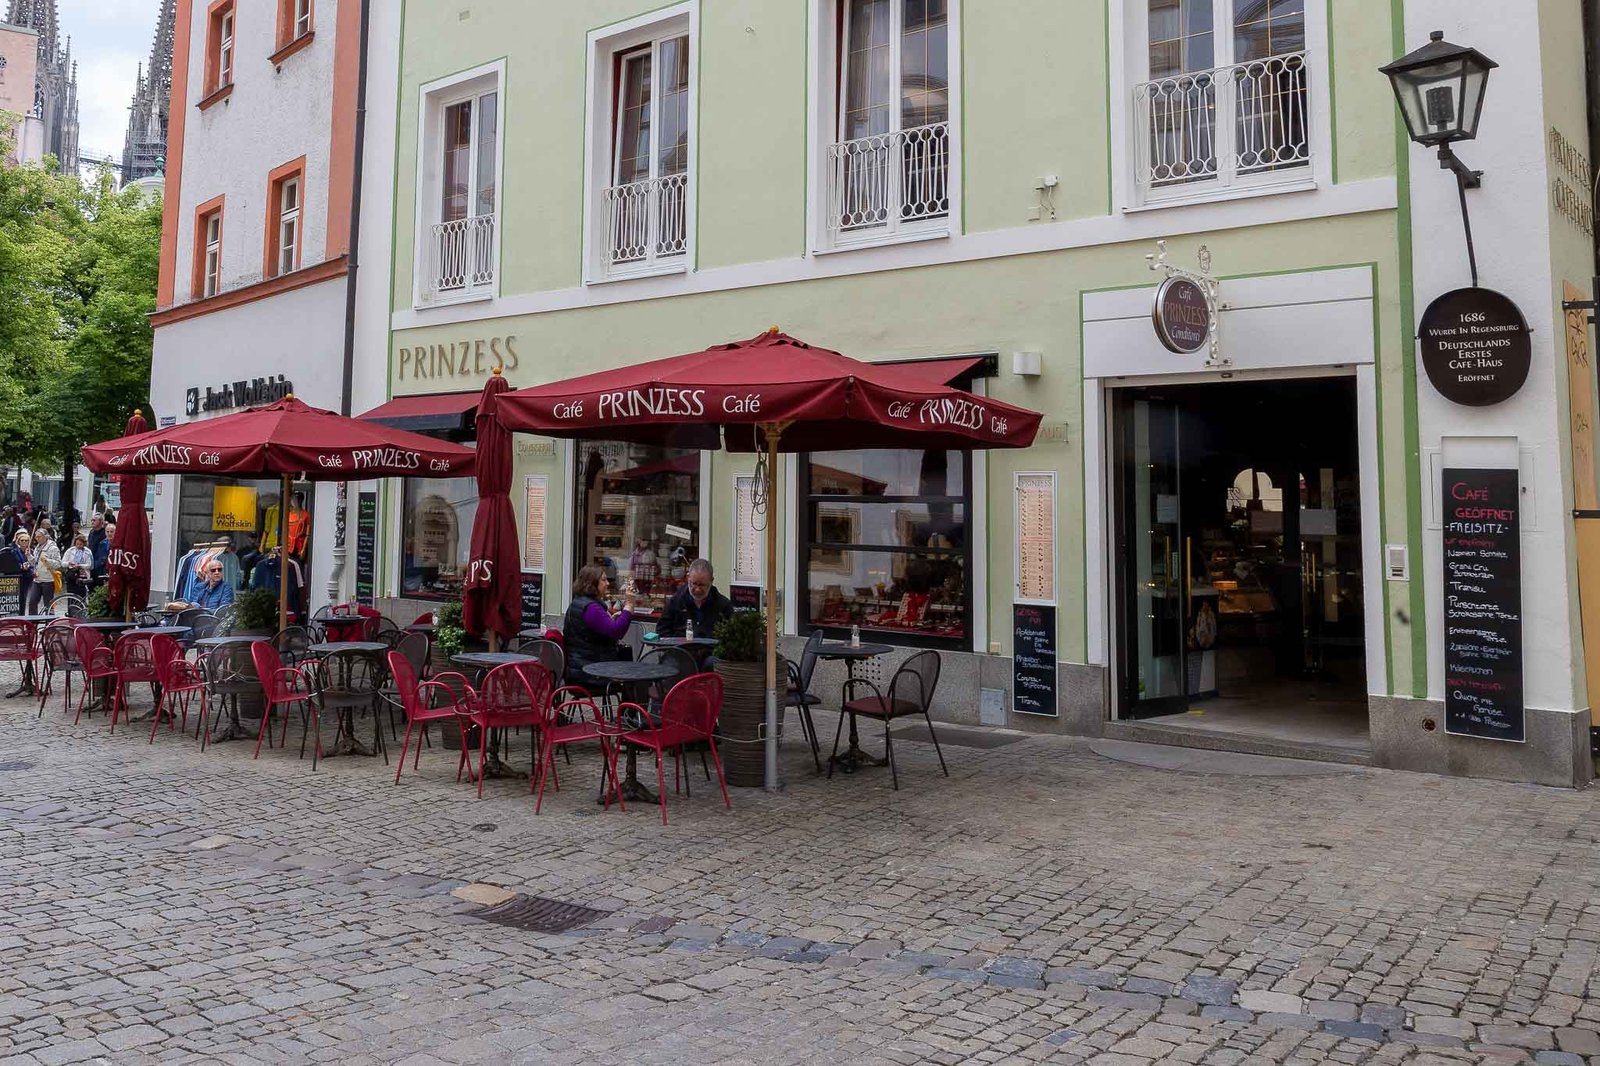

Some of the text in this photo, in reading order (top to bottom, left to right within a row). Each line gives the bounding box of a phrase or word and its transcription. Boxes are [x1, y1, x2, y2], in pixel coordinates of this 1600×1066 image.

[1179, 286, 1192, 302] Café
[1164, 301, 1207, 327] PRINZESS
[1460, 312, 1486, 322] 1686
[399, 335, 519, 381] PRINZESS
[553, 388, 760, 419] Café PRINZESS Café
[887, 398, 1008, 435] Café PRINZESS Café
[108, 444, 221, 466] Café PRINZESS Café
[318, 448, 450, 472] Café PRINZESS Café
[1452, 482, 1489, 500] CAFÉ
[216, 512, 235, 520] Jack
[216, 520, 252, 528] Wolfskin
[1455, 507, 1515, 521] GEÖFFNET
